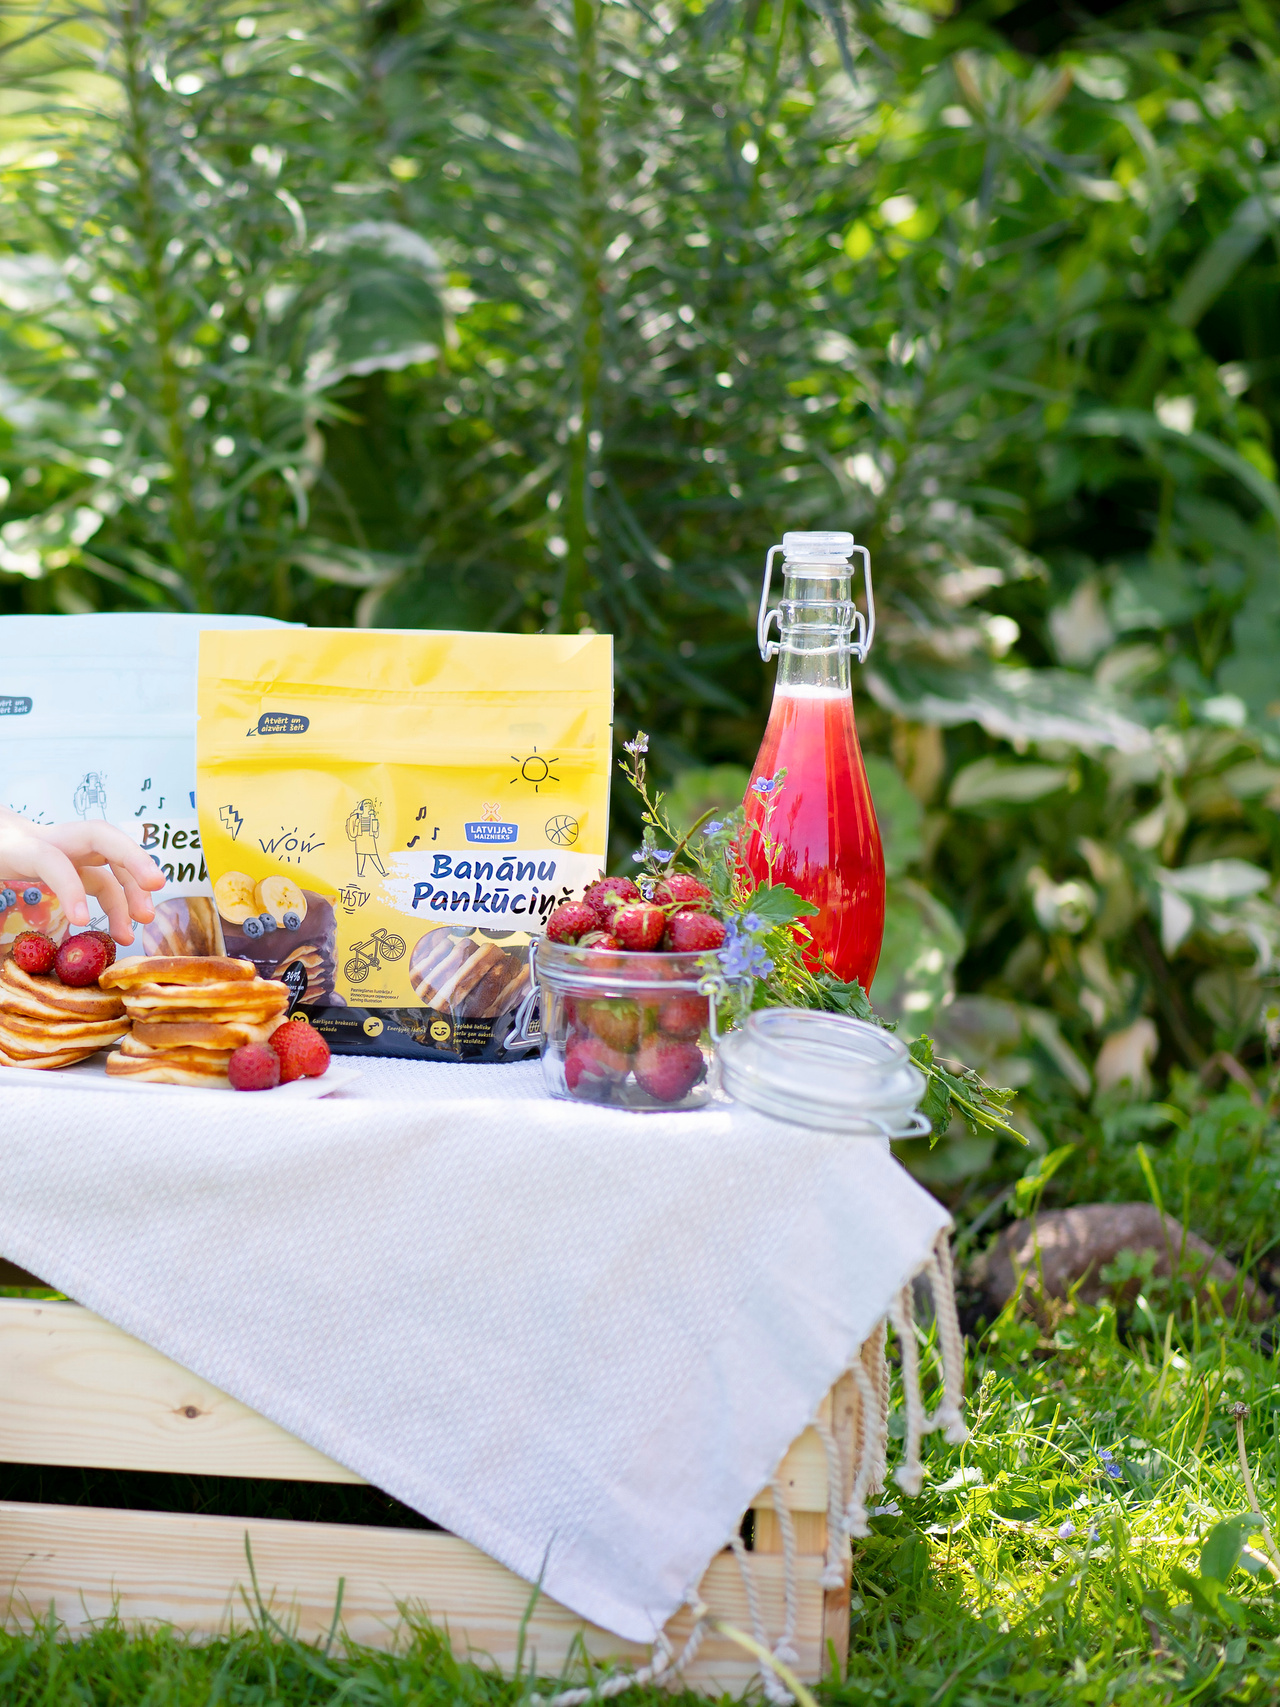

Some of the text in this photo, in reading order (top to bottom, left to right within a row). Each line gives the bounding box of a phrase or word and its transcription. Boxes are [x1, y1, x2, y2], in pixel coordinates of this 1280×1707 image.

[264, 717, 289, 725] Atvērt
[261, 723, 305, 732] aizvērt šeit
[470, 825, 513, 834] LATVIJAS
[430, 853, 557, 882] Banānu
[338, 888, 371, 907] TASTY
[284, 970, 301, 982] 34%
